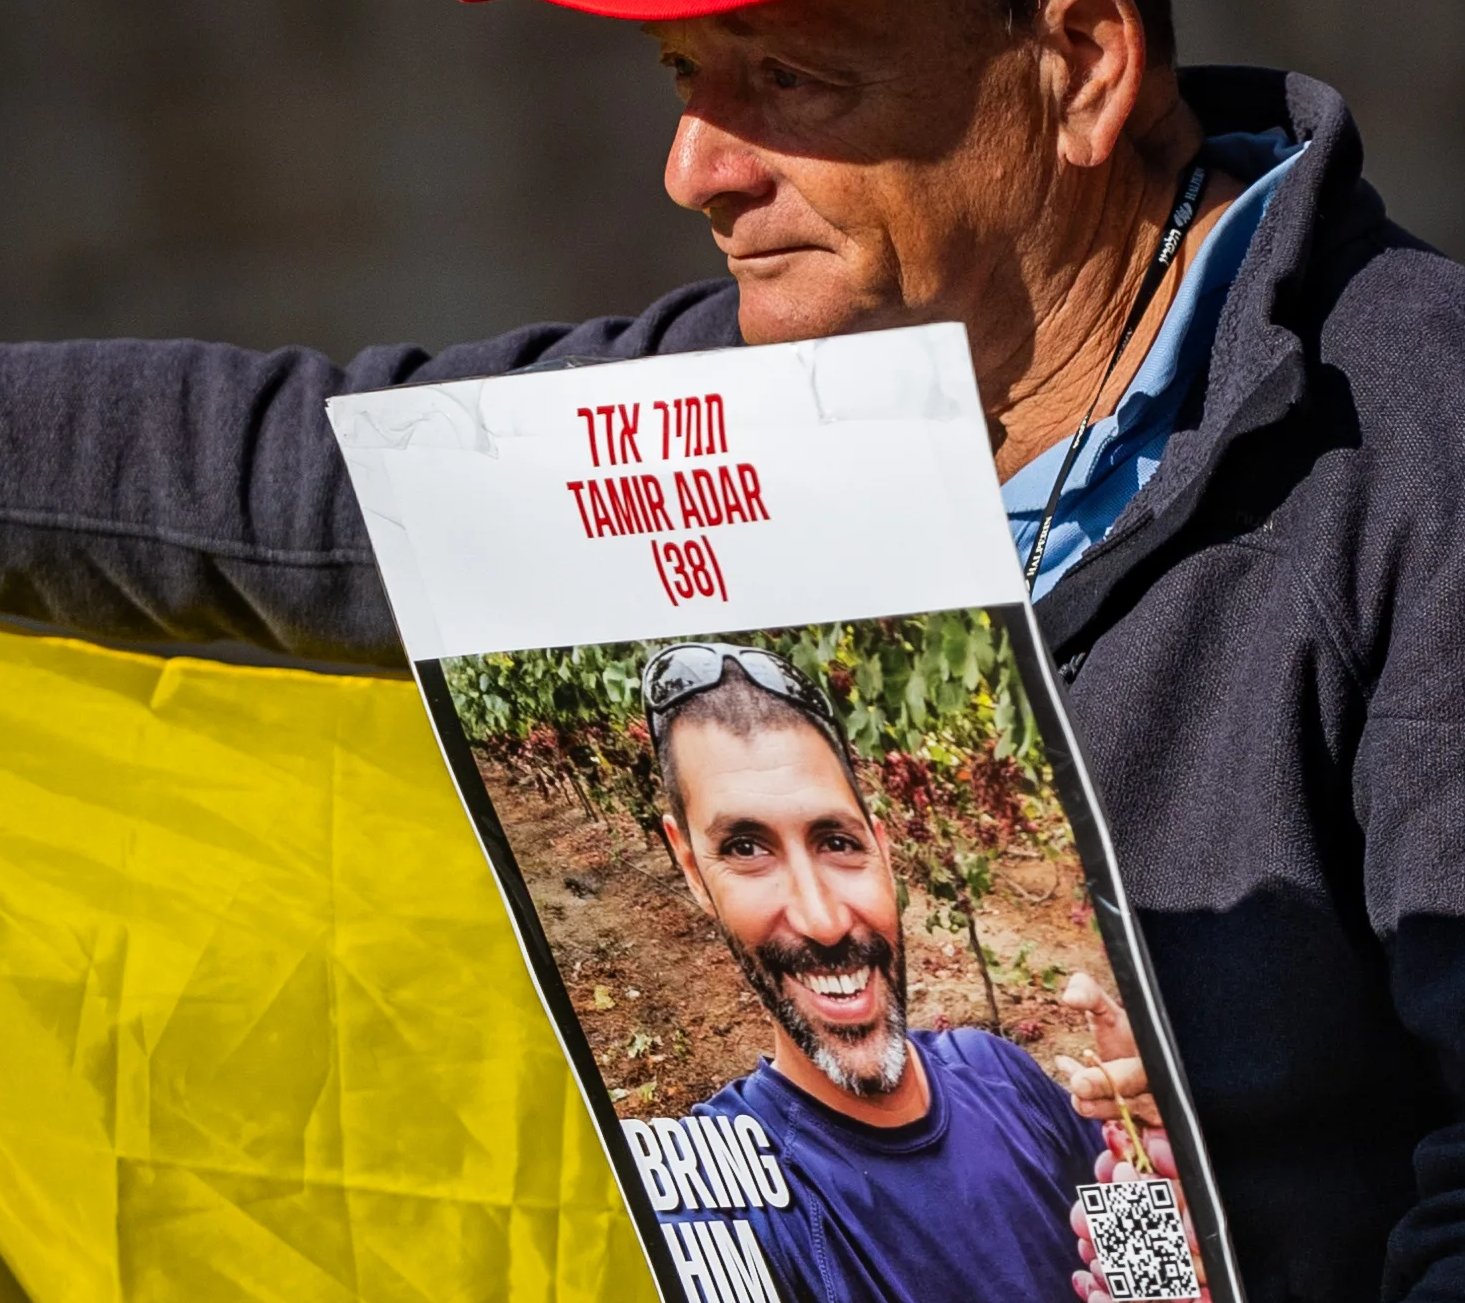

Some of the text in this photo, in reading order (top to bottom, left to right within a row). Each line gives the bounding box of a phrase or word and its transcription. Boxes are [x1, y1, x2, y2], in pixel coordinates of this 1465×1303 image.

[576, 393, 728, 467] תמיר אדר
[566, 463, 771, 539] TAMIR ADAR
[651, 535, 729, 607] (38)
[619, 1114, 791, 1212] BRING
